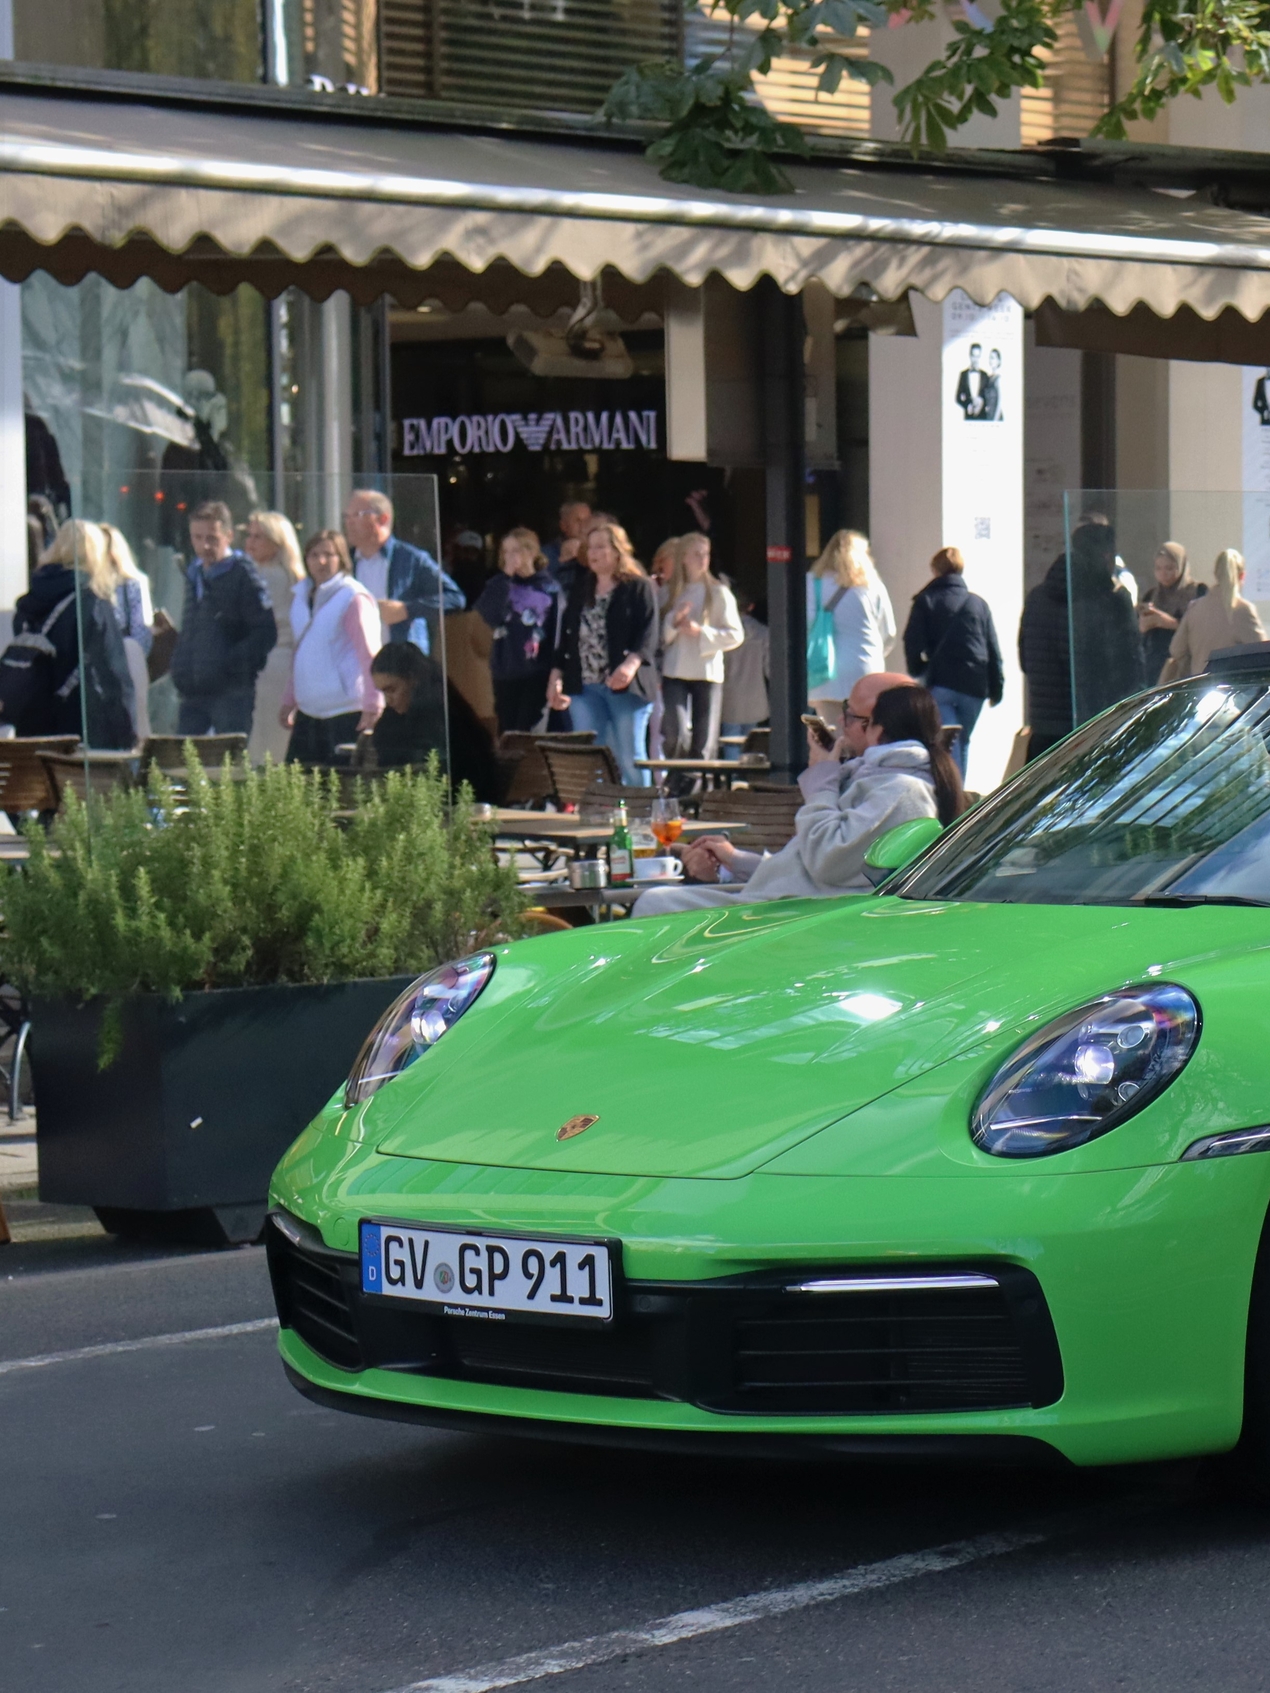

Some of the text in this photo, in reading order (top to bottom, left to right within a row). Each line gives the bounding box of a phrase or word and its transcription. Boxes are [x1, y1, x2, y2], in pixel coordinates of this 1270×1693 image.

[402, 410, 658, 456] EMPORIO ARMANI
[368, 1265, 377, 1281] D
[384, 1234, 604, 1307] GV GP 911
[443, 1305, 506, 1320] Porsche Zentrum Essen
